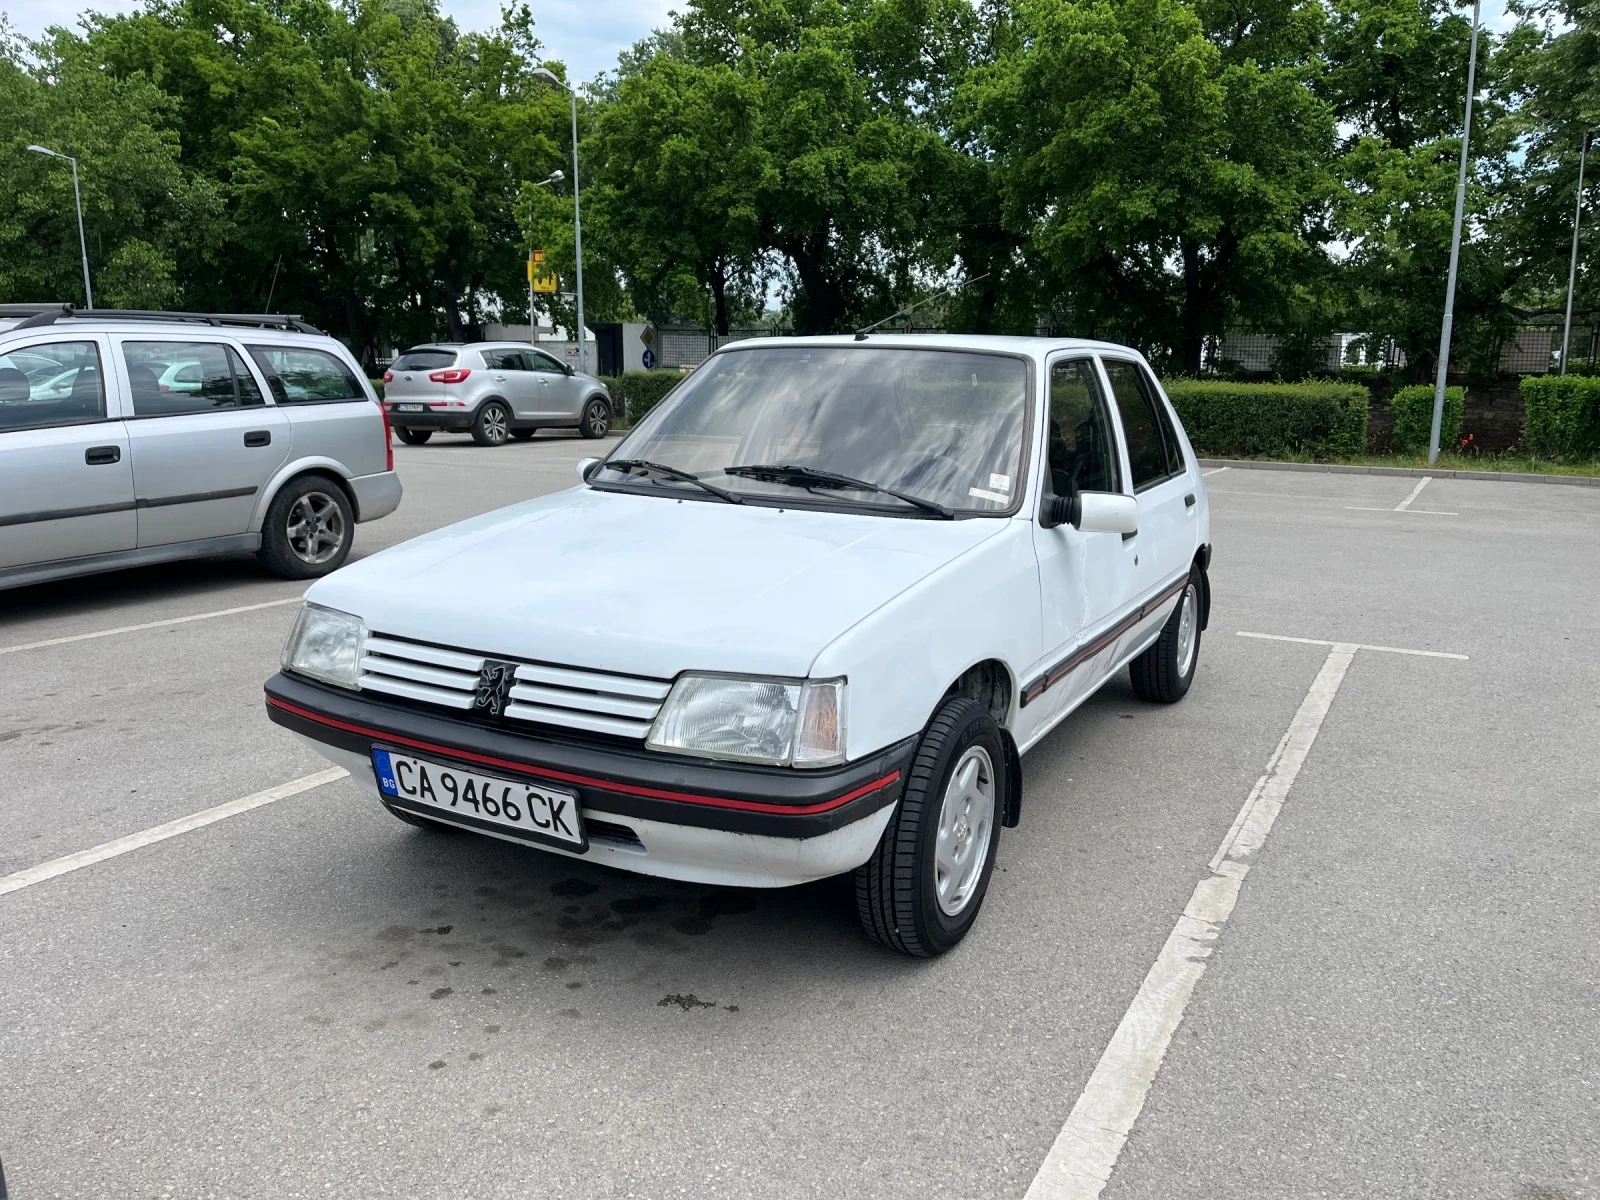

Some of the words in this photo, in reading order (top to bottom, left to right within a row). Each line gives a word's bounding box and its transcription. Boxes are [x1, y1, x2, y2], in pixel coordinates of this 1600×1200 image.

[382, 777, 396, 789] BG
[395, 760, 437, 802] CA
[440, 772, 522, 821] 9466
[526, 792, 574, 837] CK
